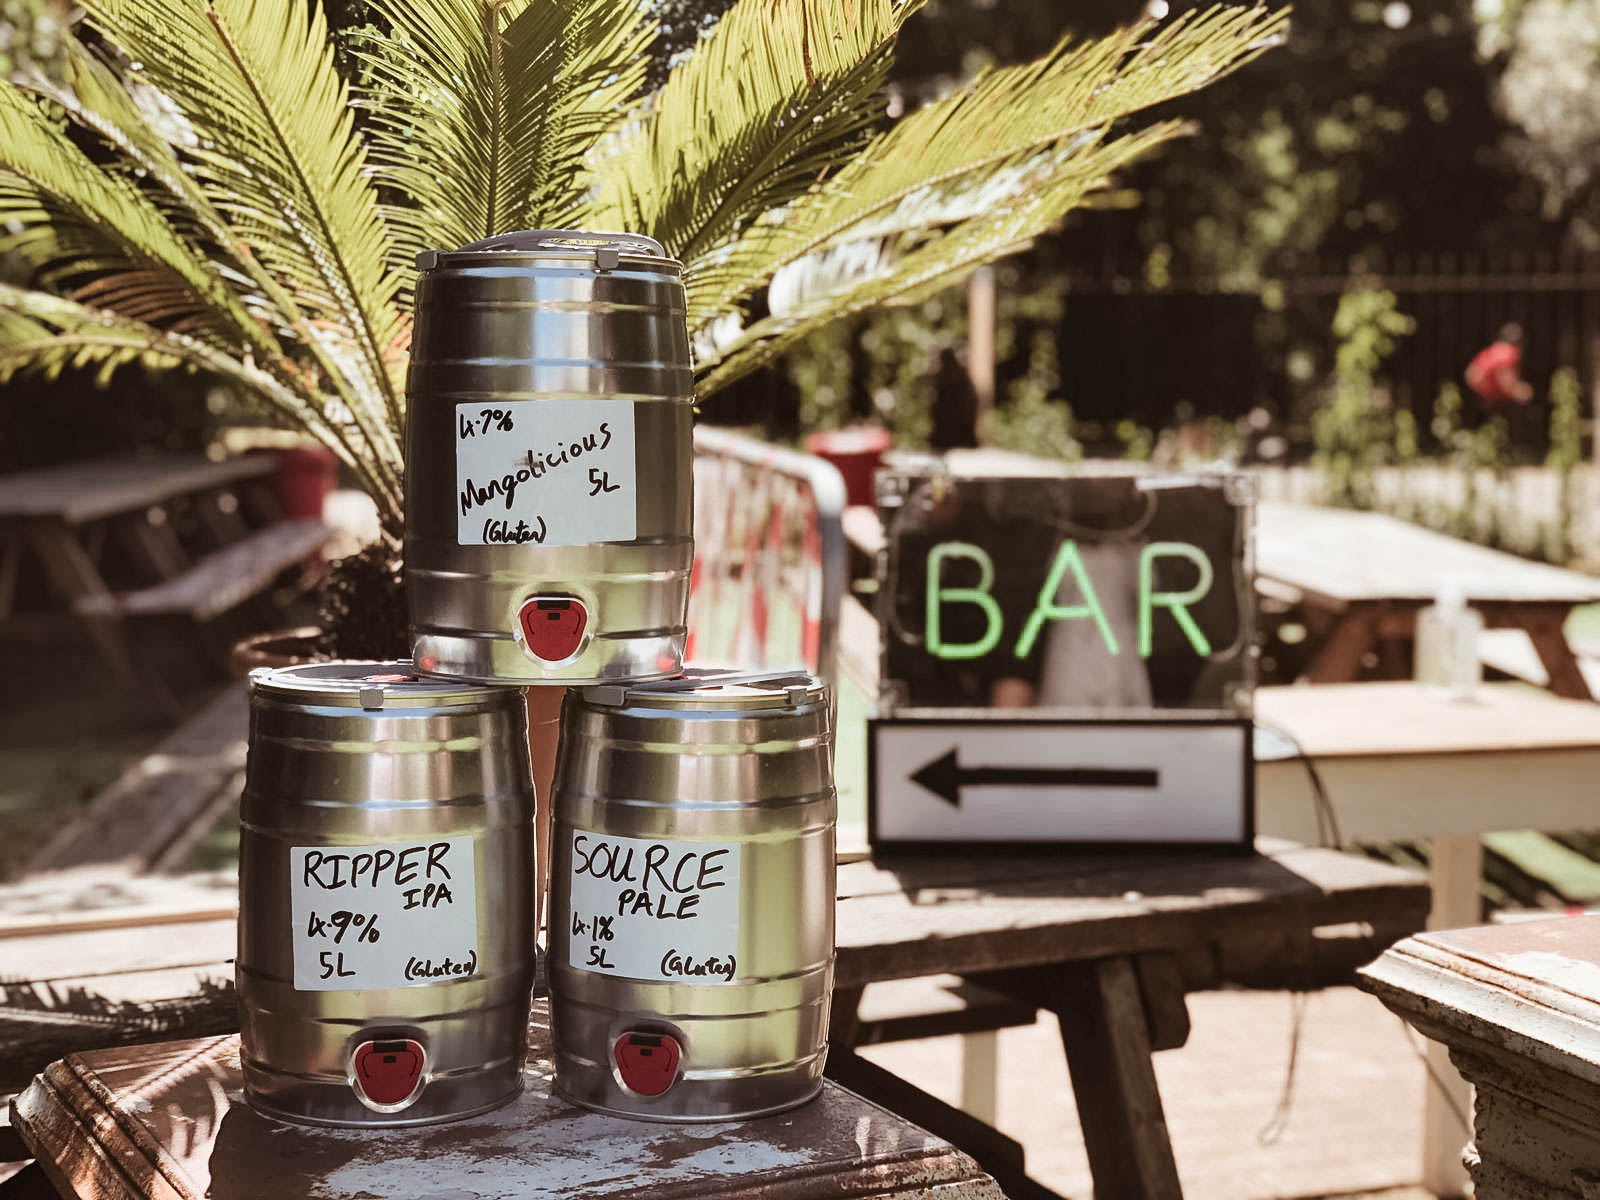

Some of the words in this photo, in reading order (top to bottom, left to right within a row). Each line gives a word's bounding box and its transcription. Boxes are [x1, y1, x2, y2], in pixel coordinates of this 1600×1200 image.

[460, 409, 514, 439] 4.7%
[460, 422, 611, 516] Mangolicious
[588, 468, 620, 496] 5L
[482, 516, 547, 544] (Gluten)
[925, 539, 1214, 659] BAR
[304, 842, 451, 890] RIPPER
[574, 836, 730, 893] SOURCE
[402, 883, 453, 910] IPA
[618, 888, 700, 920] PALE
[307, 910, 380, 944] 4.9%
[572, 911, 615, 941] 4.1%
[319, 951, 356, 980] 5L
[404, 949, 477, 981] (Gluten)
[586, 946, 615, 969] 5L
